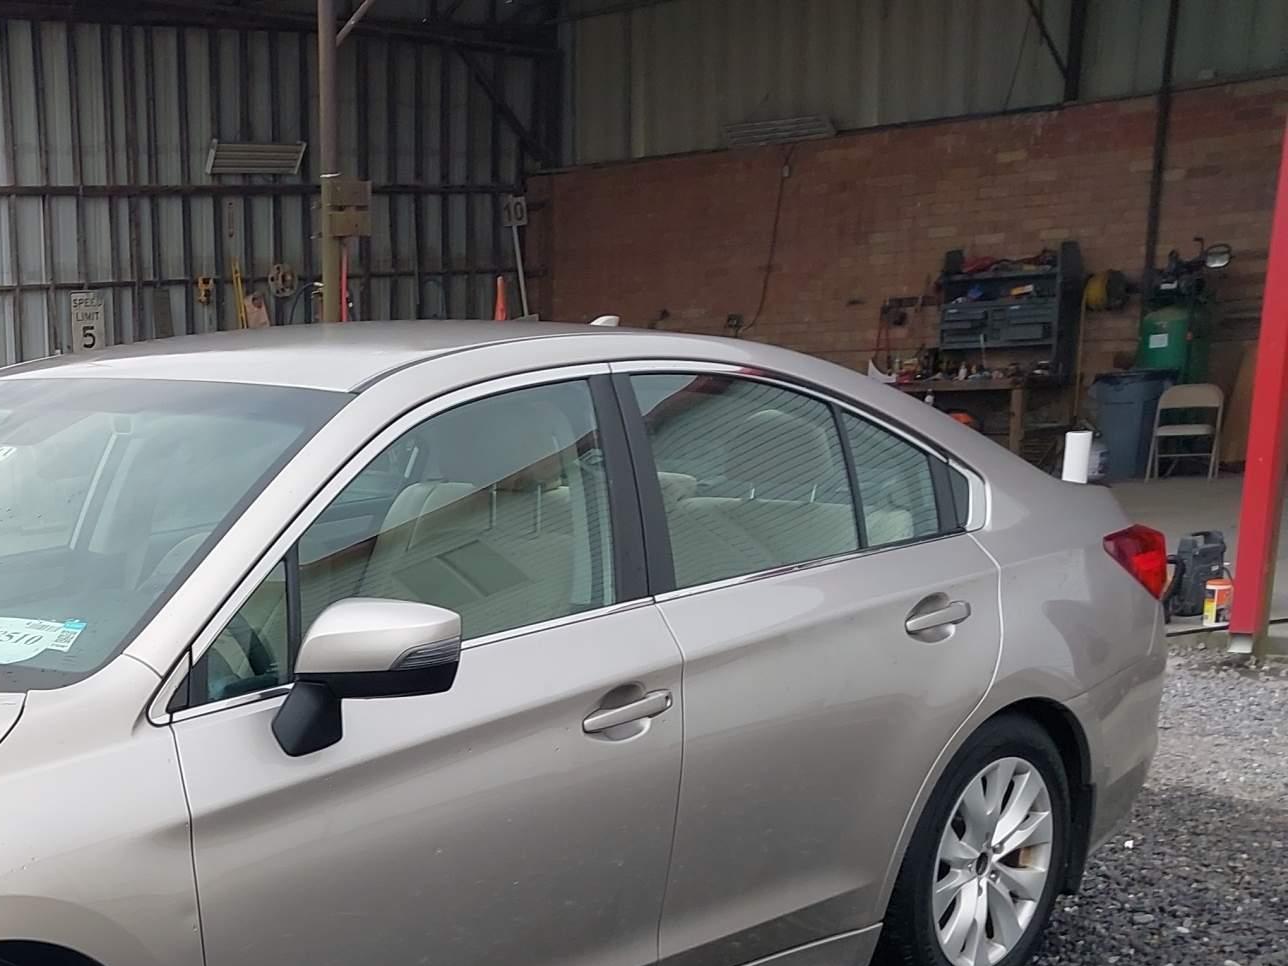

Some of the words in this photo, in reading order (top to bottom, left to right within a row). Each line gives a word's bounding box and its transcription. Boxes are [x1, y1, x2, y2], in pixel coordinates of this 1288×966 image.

[504, 201, 524, 221] 10
[76, 311, 99, 321] LIMIT
[83, 325, 96, 348] 5
